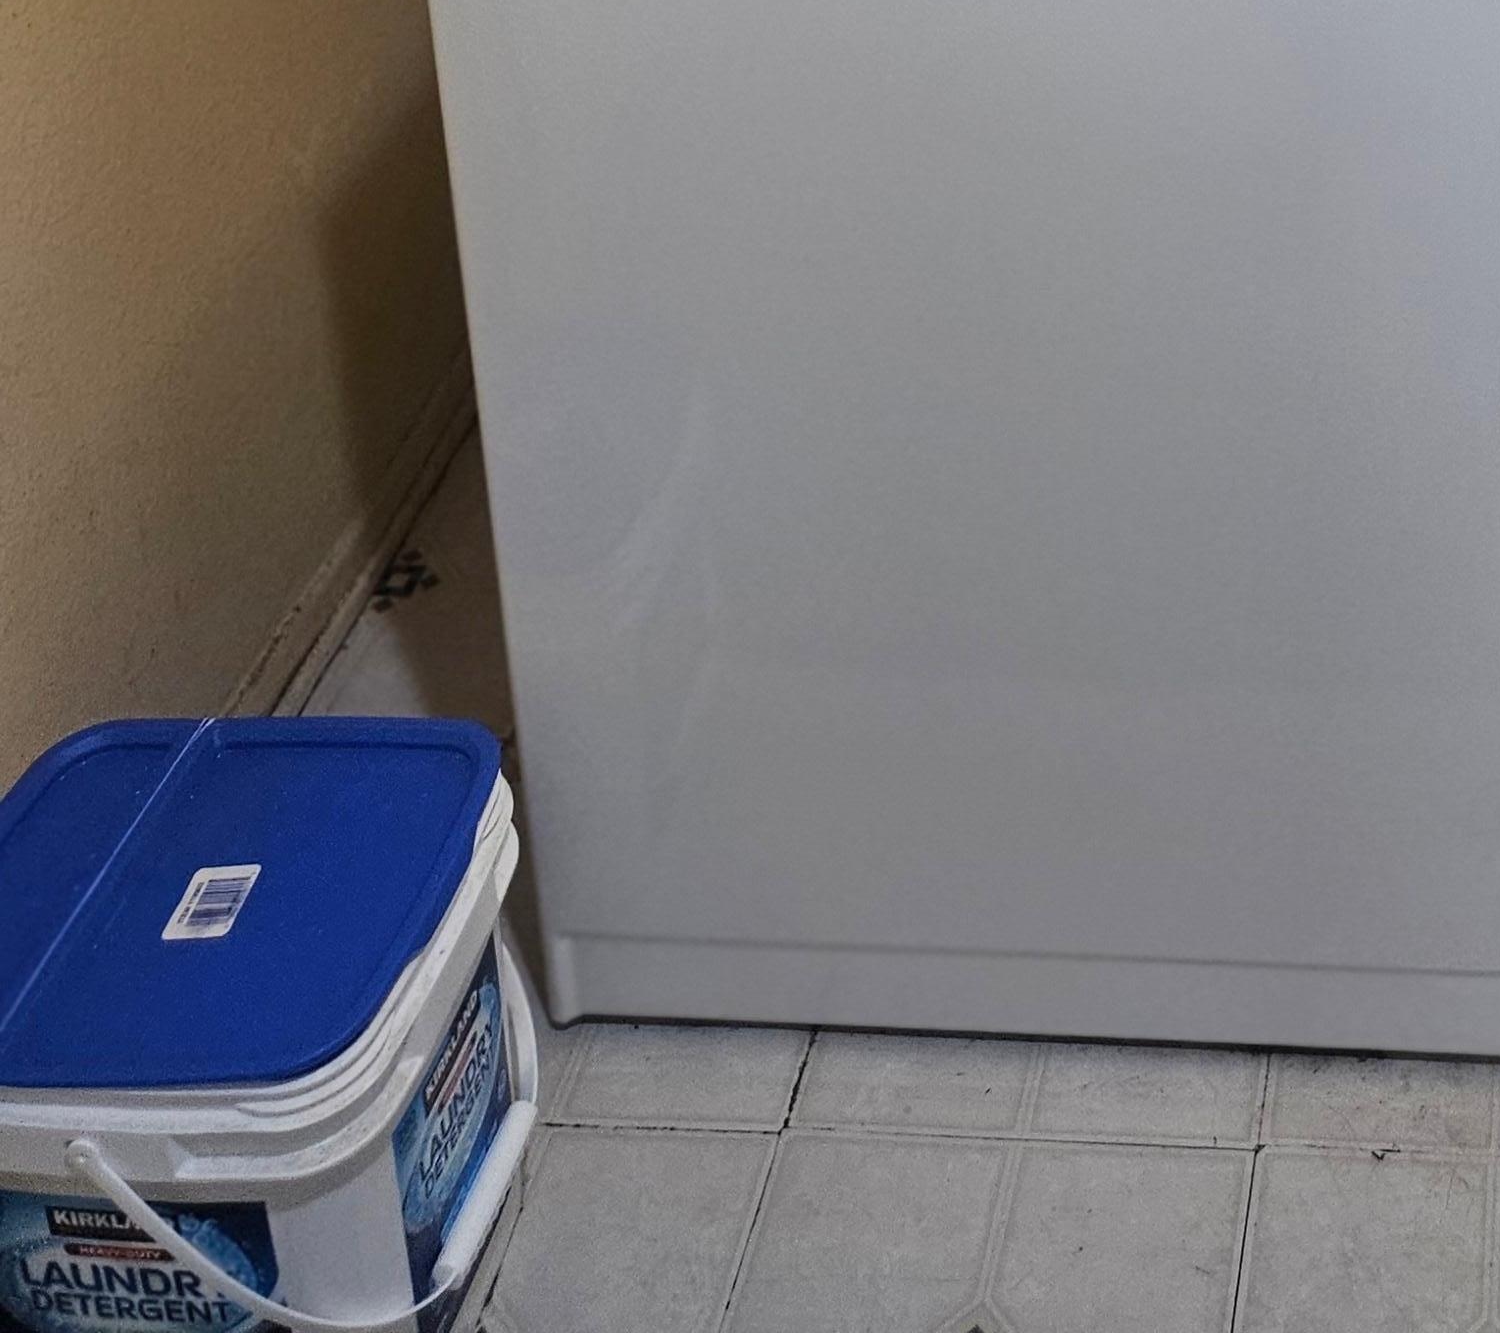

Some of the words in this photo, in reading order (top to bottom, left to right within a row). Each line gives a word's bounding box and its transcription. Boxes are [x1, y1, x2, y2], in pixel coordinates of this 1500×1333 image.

[419, 1023, 492, 1182] LAUNDRY
[20, 1257, 225, 1299] LAUNDR
[29, 1288, 231, 1325] DETERGENT
